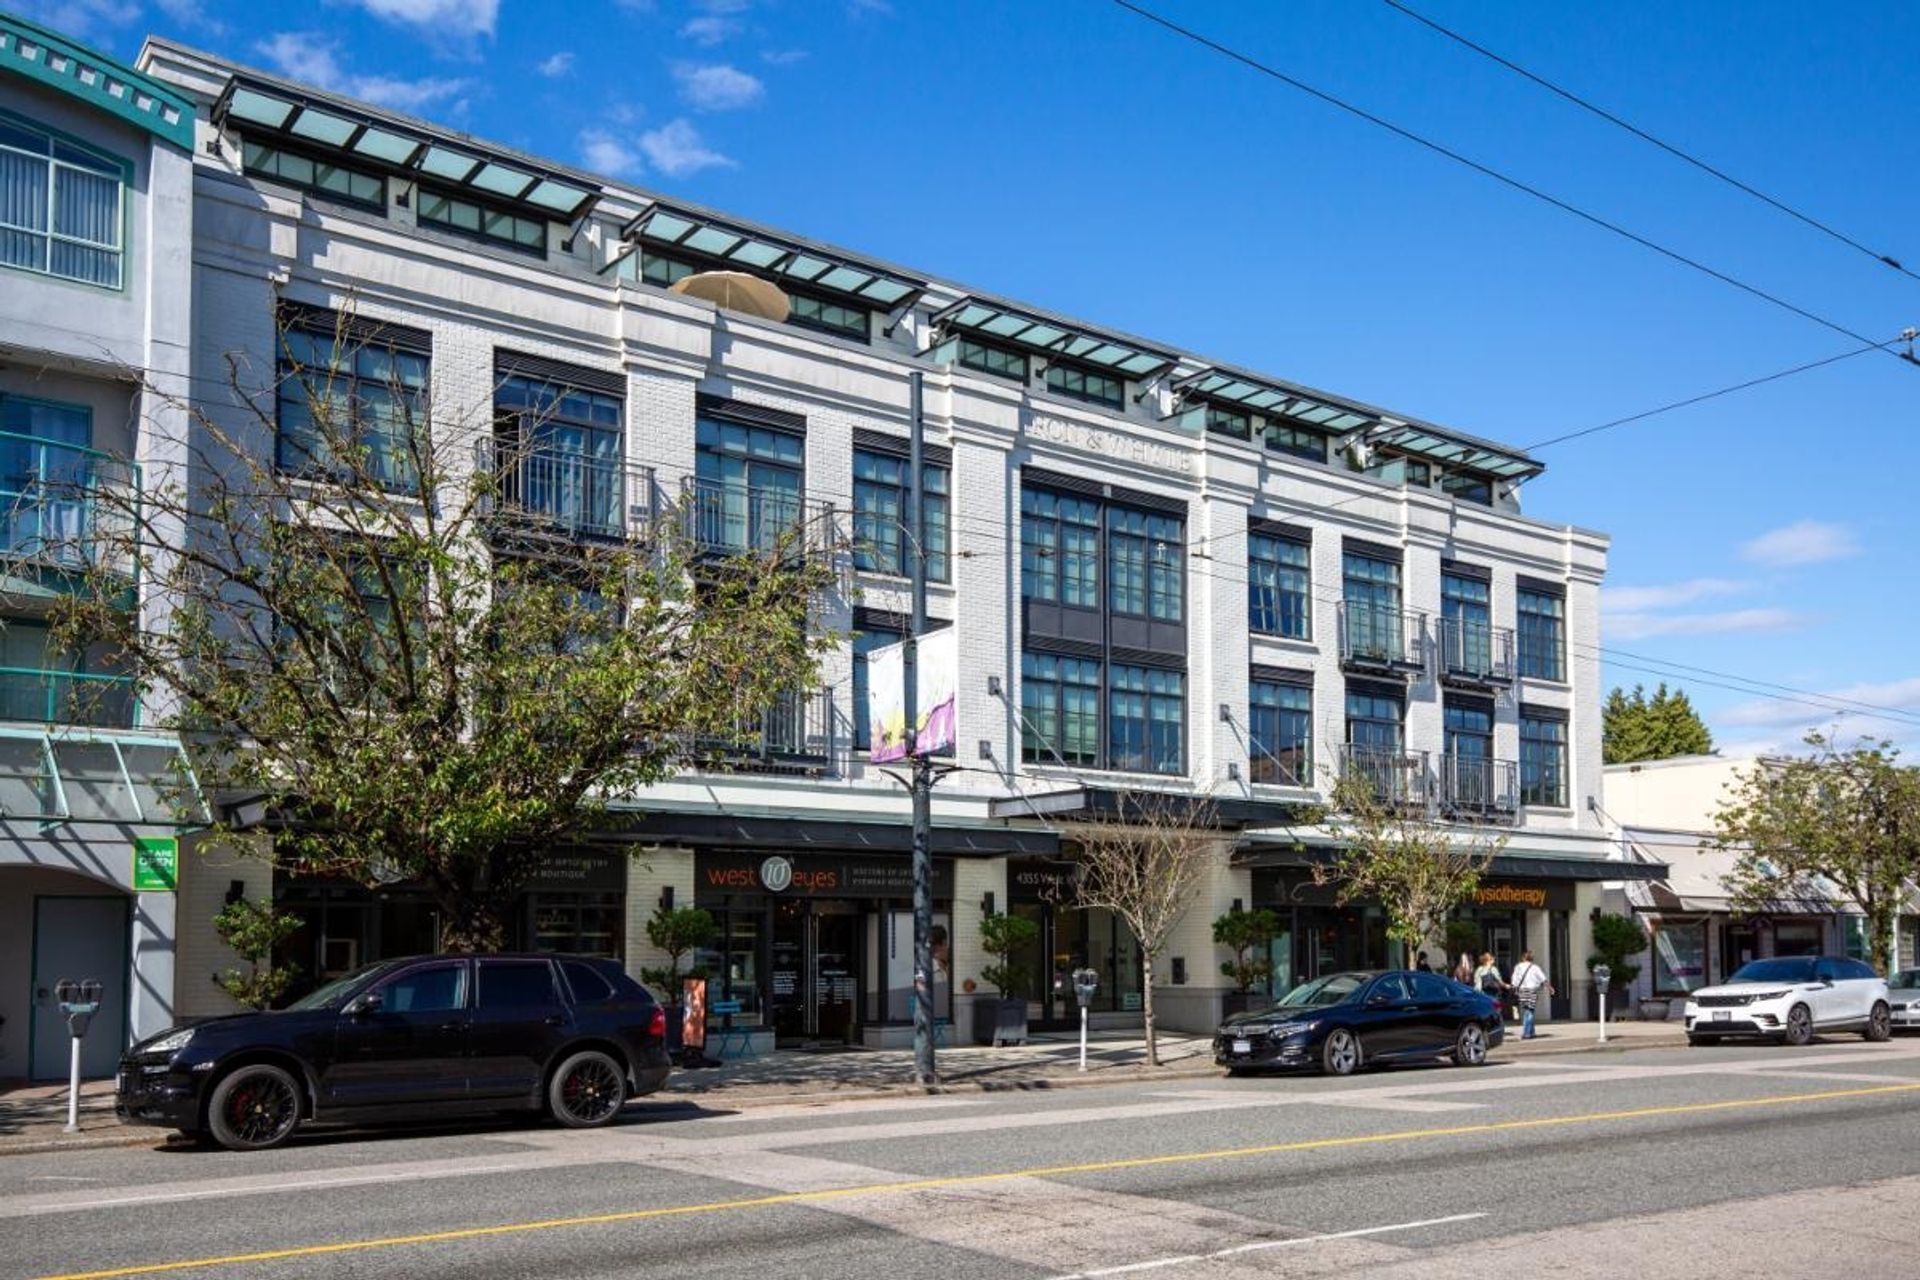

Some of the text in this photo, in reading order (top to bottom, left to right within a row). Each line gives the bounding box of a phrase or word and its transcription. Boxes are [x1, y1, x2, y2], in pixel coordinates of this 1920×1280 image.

[138, 857, 174, 866] OPEN
[708, 867, 756, 887] west
[792, 871, 836, 893] eyes
